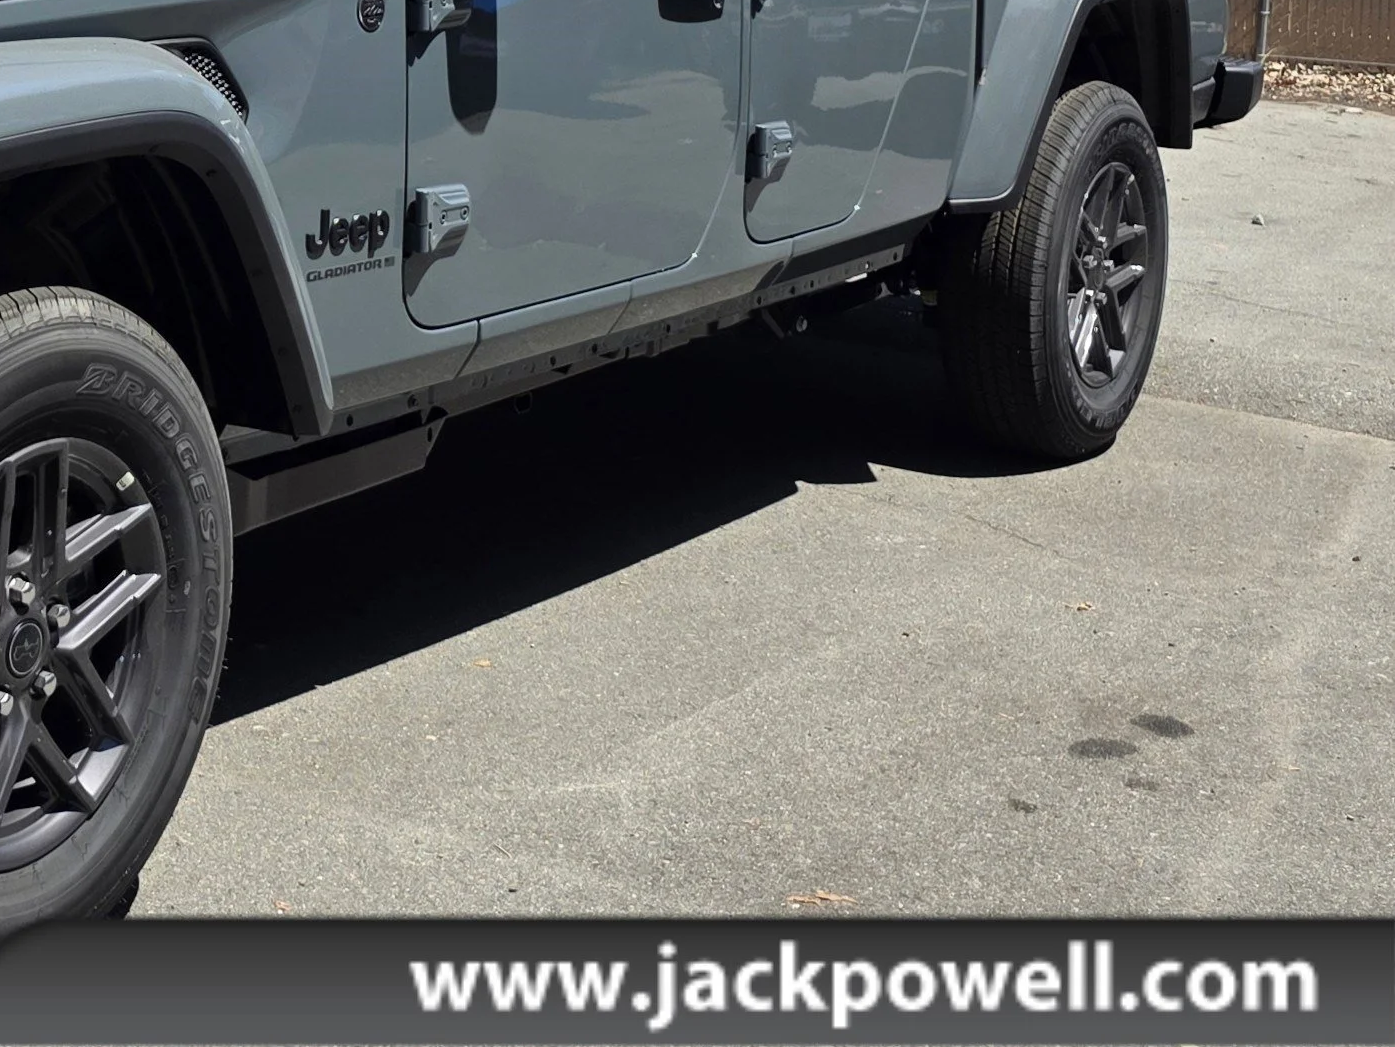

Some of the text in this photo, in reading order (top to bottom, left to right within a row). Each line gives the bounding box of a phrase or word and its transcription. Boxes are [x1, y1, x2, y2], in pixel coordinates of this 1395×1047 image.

[305, 208, 390, 261] Jeep
[306, 258, 383, 283] GLADIATOR
[75, 361, 220, 728] BRIDGESTONE
